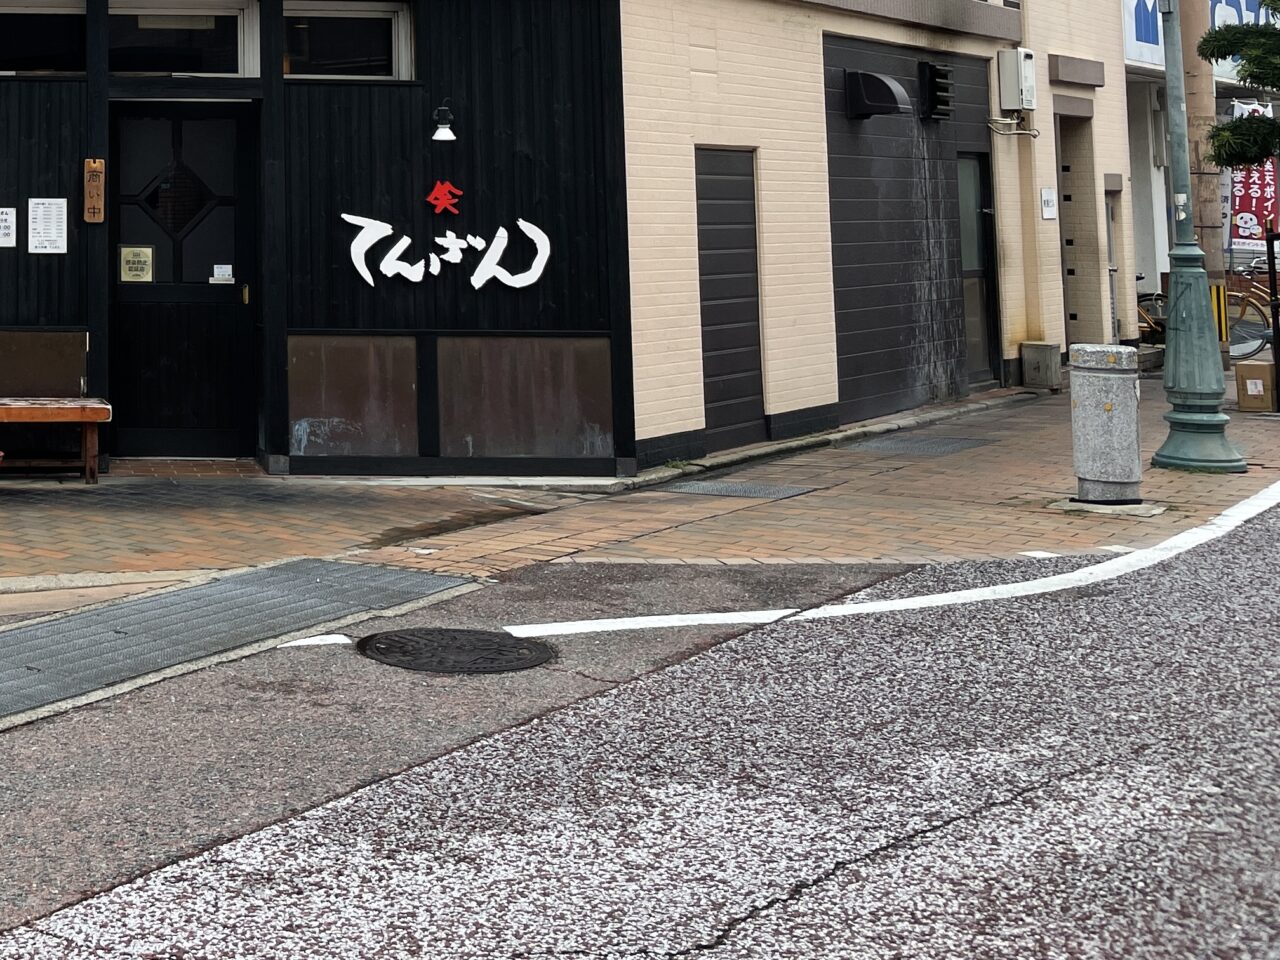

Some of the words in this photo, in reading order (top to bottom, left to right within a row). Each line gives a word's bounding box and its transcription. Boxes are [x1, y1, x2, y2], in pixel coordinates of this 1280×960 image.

[87, 170, 103, 219] 商い中
[341, 213, 551, 290] てんざん
